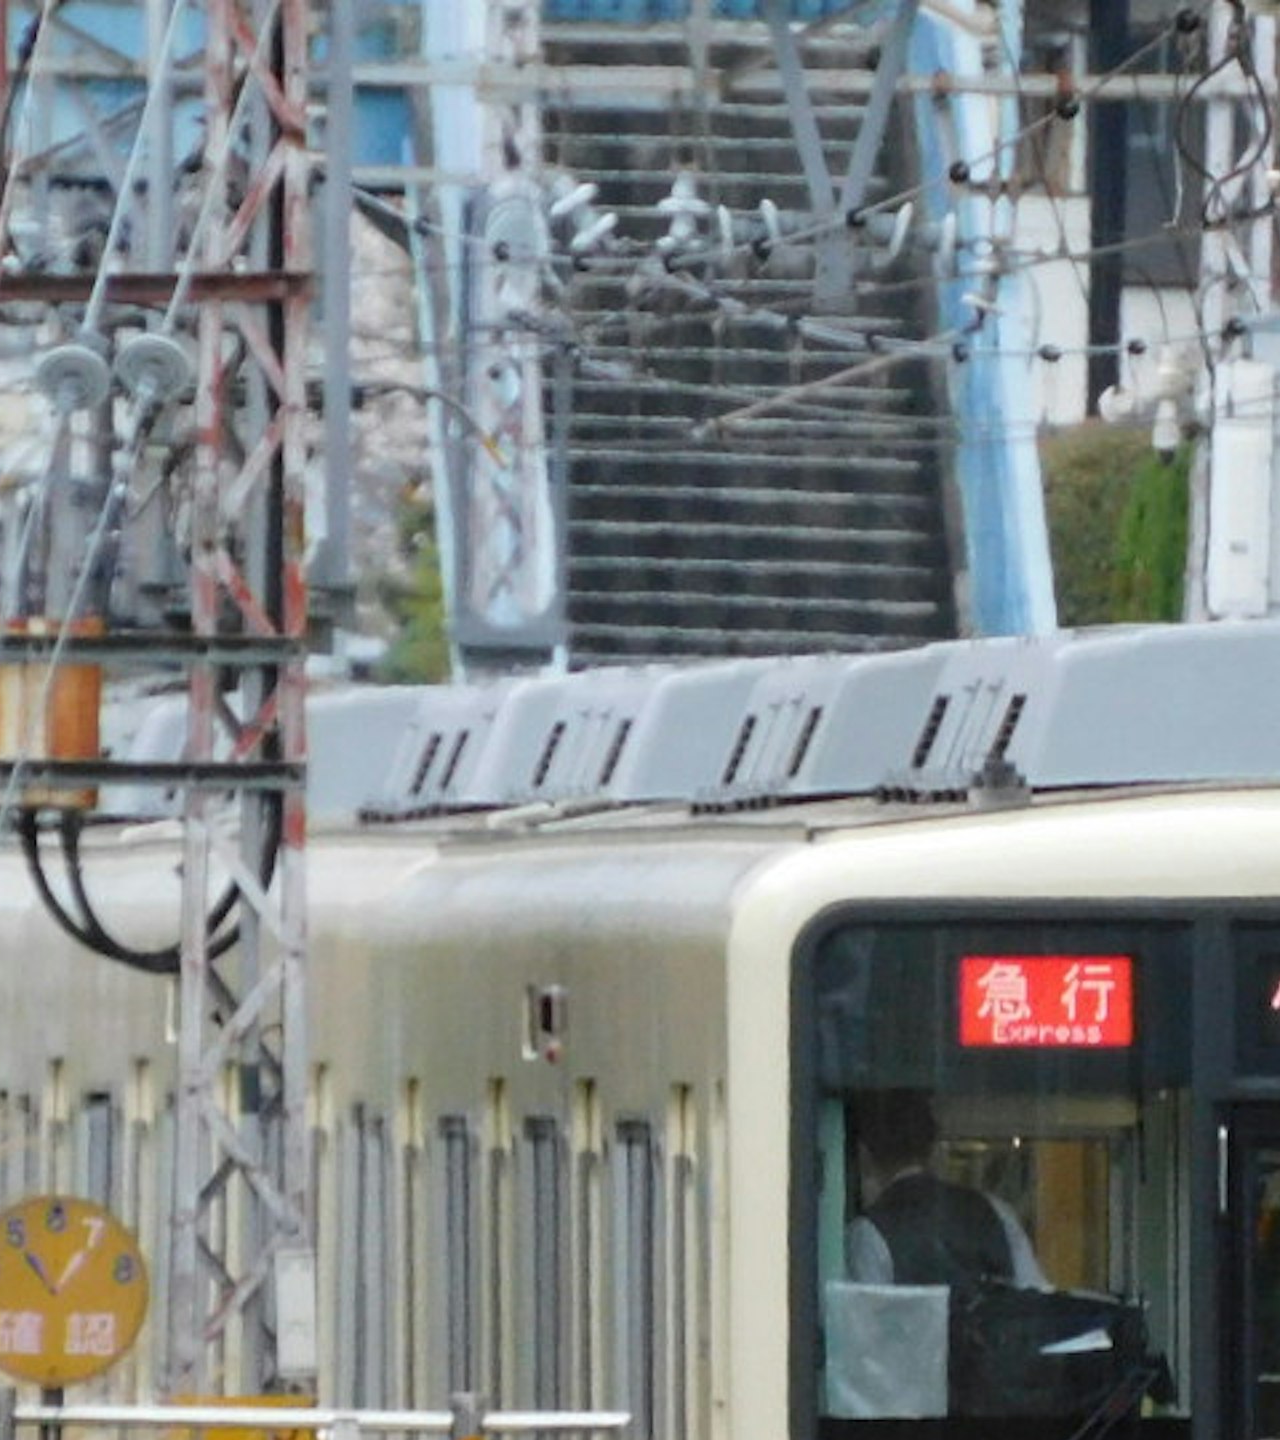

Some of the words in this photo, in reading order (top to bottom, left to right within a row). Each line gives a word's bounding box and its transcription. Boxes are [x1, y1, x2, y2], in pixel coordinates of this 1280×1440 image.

[977, 965, 1115, 1020] 急行
[991, 1020, 1102, 1044] Express
[6, 1217, 27, 1248] 5
[47, 1201, 66, 1233] 6
[81, 1217, 106, 1249] 7
